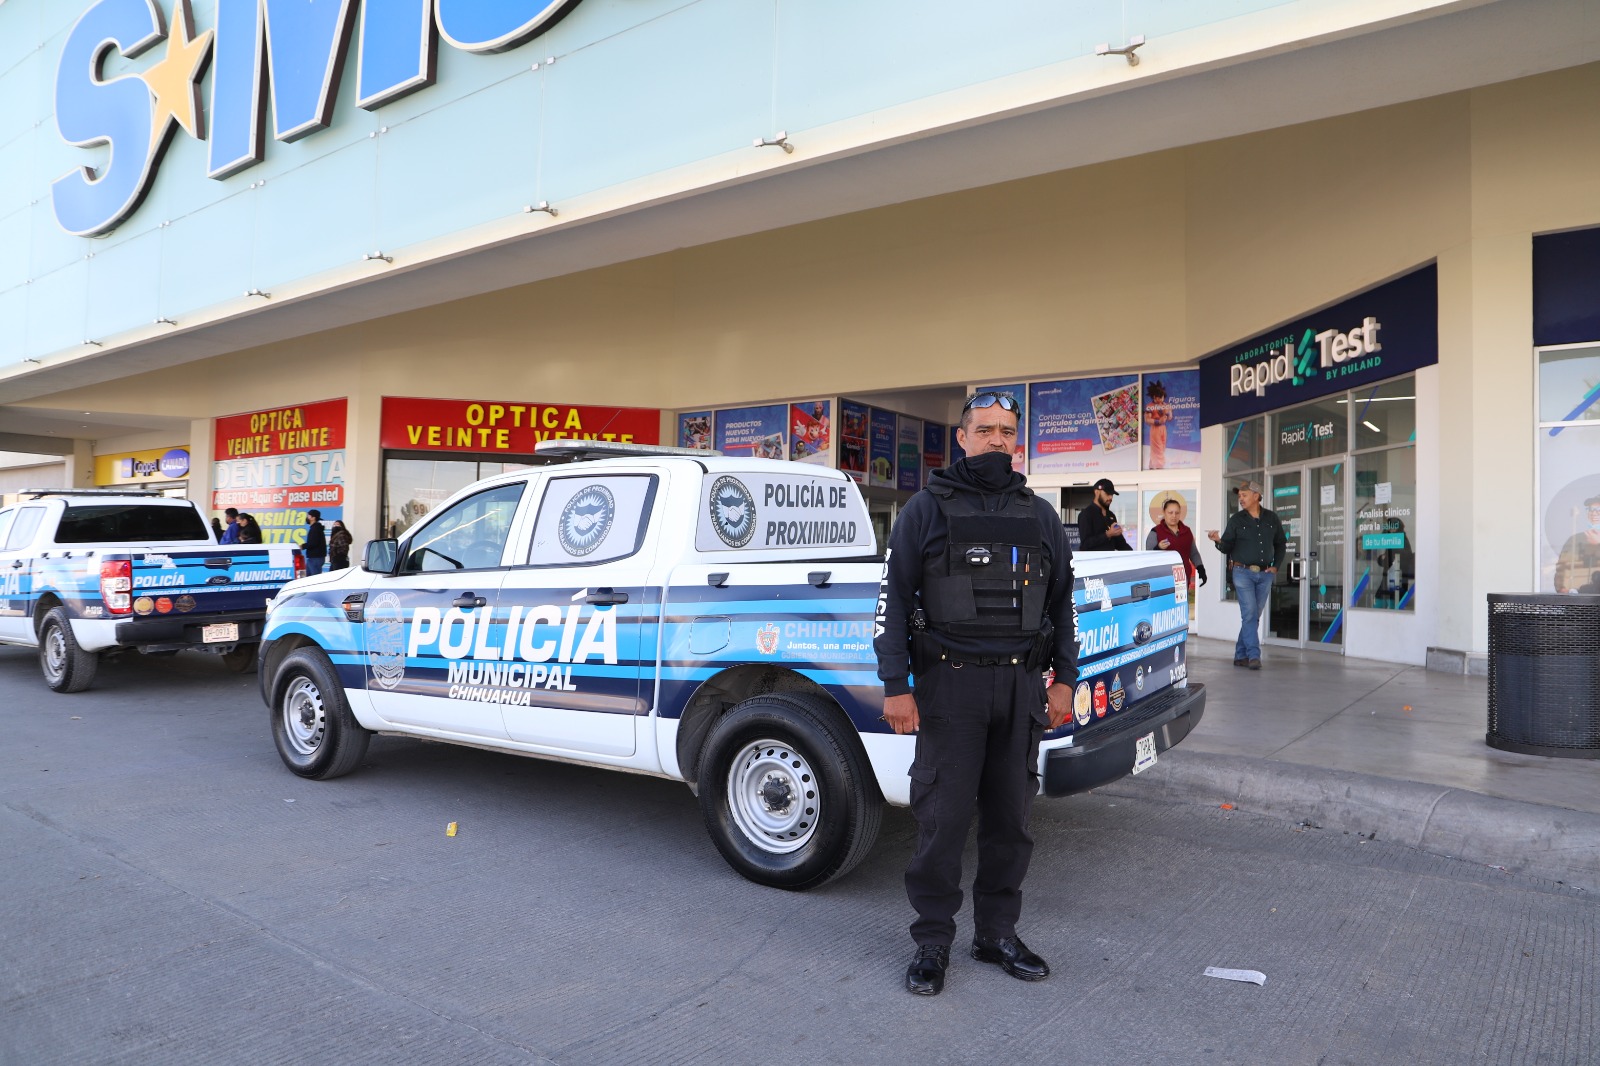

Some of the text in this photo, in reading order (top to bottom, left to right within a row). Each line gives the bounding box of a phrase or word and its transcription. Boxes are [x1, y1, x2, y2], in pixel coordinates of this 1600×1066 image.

[1231, 316, 1382, 396] Rapid Test
[1236, 335, 1294, 363] LABORATORIOS
[1326, 356, 1381, 380] BY RULAND
[466, 404, 582, 430] OPTICA
[1146, 403, 1200, 411] coleccionables
[250, 408, 302, 434] OPTICA
[725, 420, 762, 428] PRODUCTOS
[228, 427, 328, 456] VEINTE VEINTE
[407, 425, 510, 449] VEINTE
[1282, 422, 1333, 446] Rapid Test
[134, 459, 160, 476] Coppel
[214, 451, 344, 490] DENTISTA
[214, 492, 248, 505] ABIERTO
[288, 491, 310, 506] pase
[312, 487, 338, 502] usted
[564, 490, 583, 513] POLICÍA
[592, 486, 614, 508] PROXIMIDAD
[764, 480, 846, 508] POLICÍA DE
[252, 509, 306, 526] nsulta
[1360, 521, 1399, 532] para la salud
[261, 528, 307, 545] ATIS
[585, 521, 612, 553] COMUNIDAD
[766, 521, 856, 545] PROXIMIDAD
[1382, 537, 1402, 545] familia
[134, 570, 292, 588] POLICÍA MUNICIPAL
[407, 588, 618, 665] POLICÍA
[785, 622, 876, 638] CHIHUAH
[1078, 605, 1186, 659] POLICÍA MUNICIPAL
[787, 641, 820, 651] Juntos,
[842, 642, 870, 652] mejor
[447, 661, 577, 691] MUNICIPAL
[448, 684, 531, 706] CHIHUAHUA
